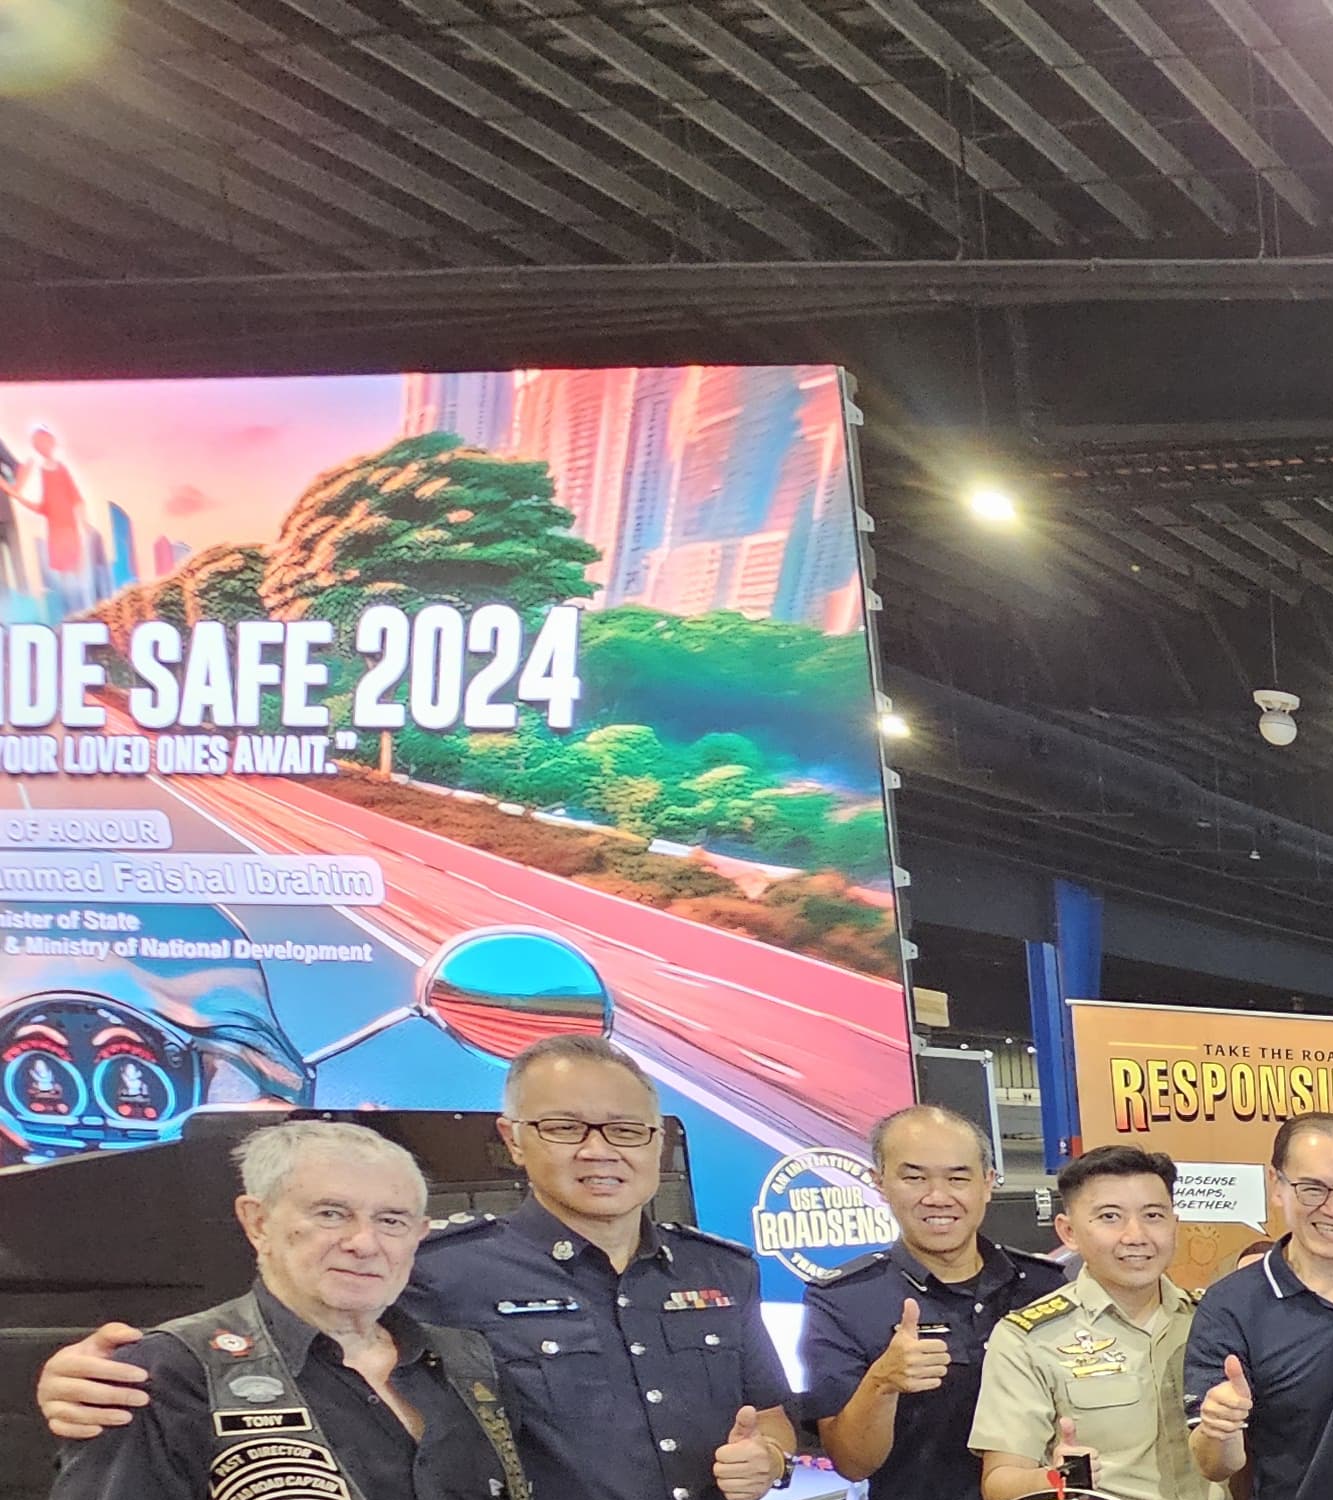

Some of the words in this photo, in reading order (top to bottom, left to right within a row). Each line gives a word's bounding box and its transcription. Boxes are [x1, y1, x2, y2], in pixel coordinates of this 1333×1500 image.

[0, 621, 109, 728] DE
[127, 620, 336, 729] SAFE
[353, 604, 581, 729] 2024
[64, 735, 149, 774] LOVED
[156, 734, 230, 774] ONES
[8, 819, 34, 842] OF
[50, 819, 160, 844] HONOUR
[0, 862, 104, 891] mmad
[112, 861, 235, 894] Faishal
[246, 863, 373, 896] Ibrahim
[0, 909, 53, 929] ister
[56, 909, 80, 930] of
[83, 909, 141, 931] State
[4, 935, 20, 954] &
[25, 935, 110, 960] Ministry
[114, 937, 138, 957] of
[140, 937, 232, 959] National
[234, 938, 373, 963] Development
[1203, 1043, 1251, 1059] TAKE
[1259, 1046, 1294, 1061] THE
[783, 1152, 861, 1177] INITIATIVE
[1174, 1188, 1226, 1198] HAMPS,
[1177, 1176, 1237, 1186] ADSENSE
[789, 1187, 823, 1211] USE
[821, 1185, 865, 1209] YOUR
[1173, 1200, 1237, 1210] GETHER!
[242, 1415, 283, 1427] TONY
[214, 1454, 245, 1477] PAST
[247, 1445, 313, 1459] DIRECTOR
[251, 1476, 285, 1495] ROAD
[285, 1475, 339, 1492] CAPTAIN
